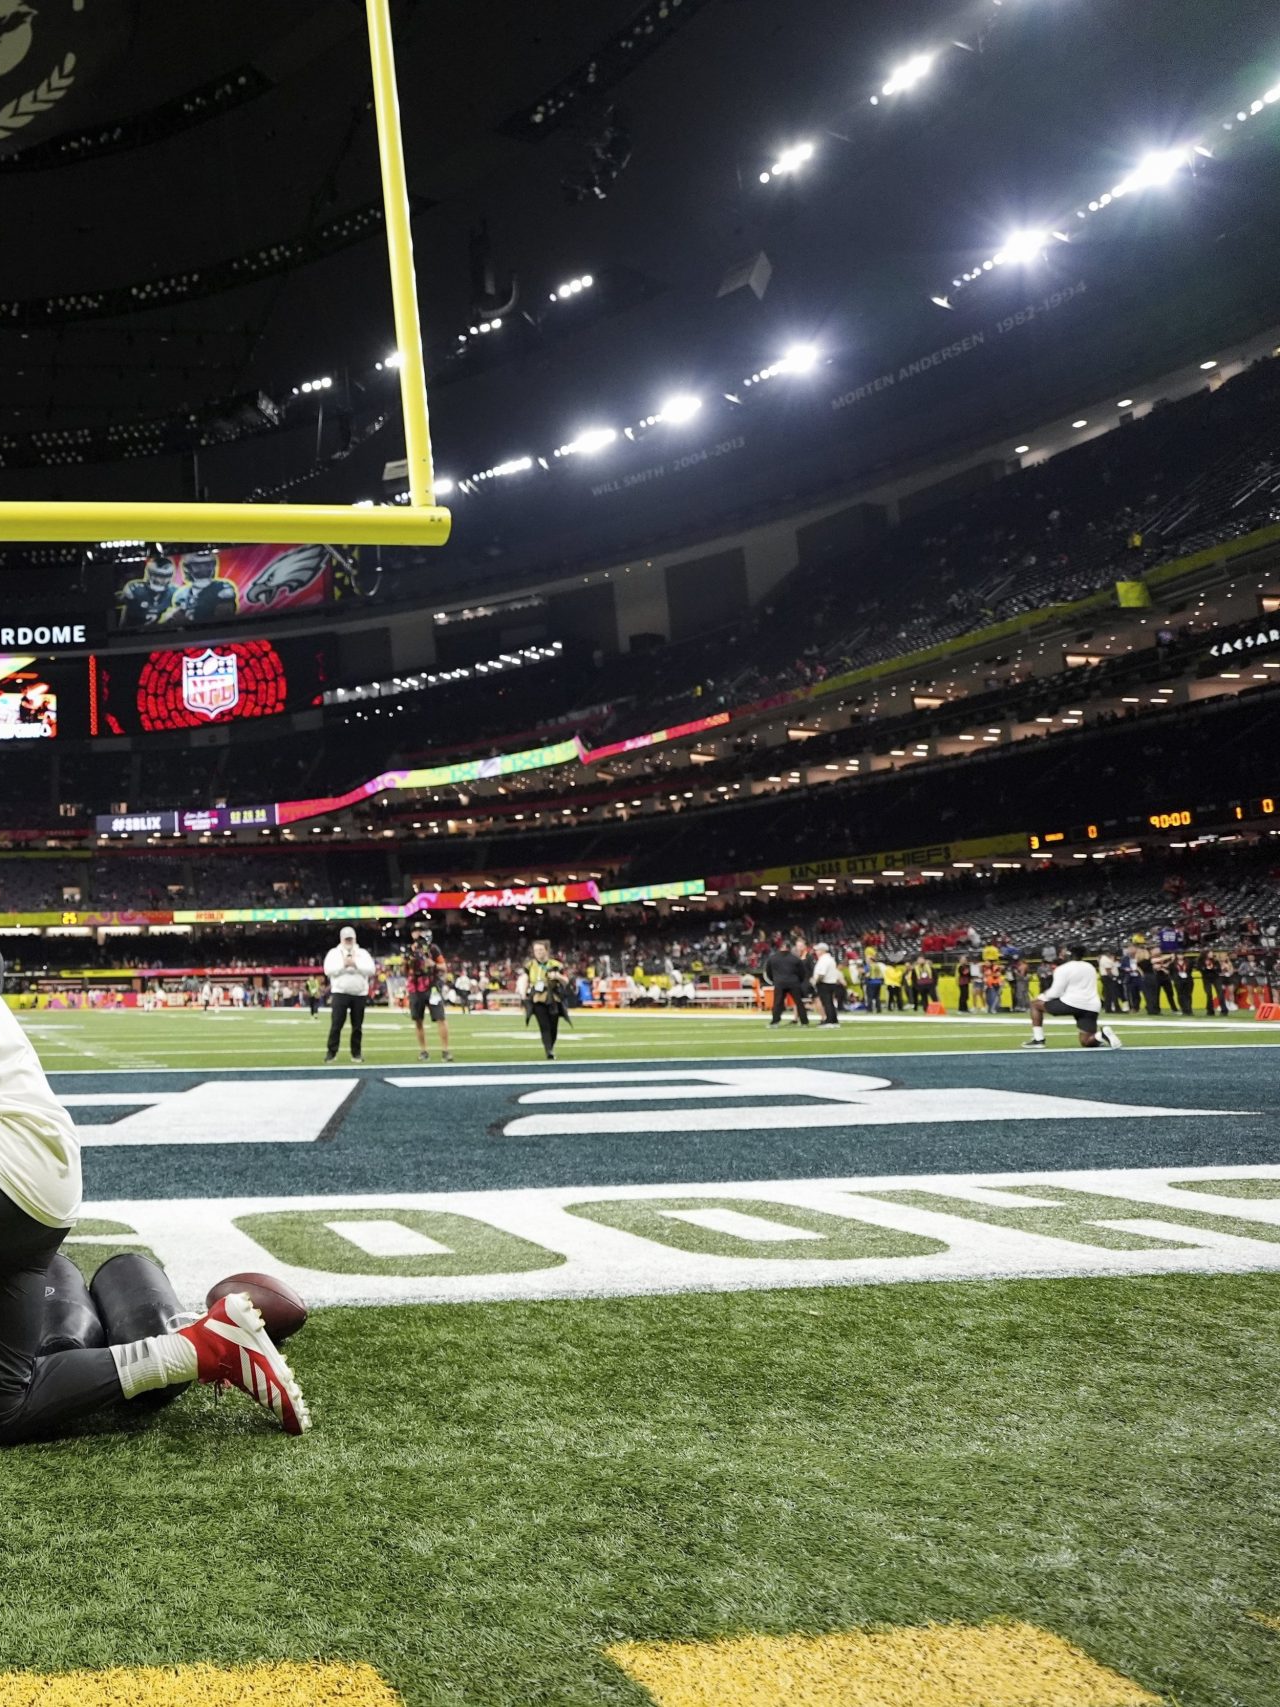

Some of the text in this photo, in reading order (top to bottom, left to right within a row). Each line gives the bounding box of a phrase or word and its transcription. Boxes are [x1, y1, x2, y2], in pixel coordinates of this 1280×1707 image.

[831, 373, 895, 411] MORTEN
[898, 331, 985, 382] ANDERSEN
[591, 436, 746, 497] WILL SMITH 2004-2013
[189, 678, 234, 707] NFL
[111, 816, 162, 832] #SBLIX
[1149, 811, 1191, 829] 90:00
[789, 846, 951, 881] KANSAS CITY CHIEFS
[533, 885, 566, 904] LIX
